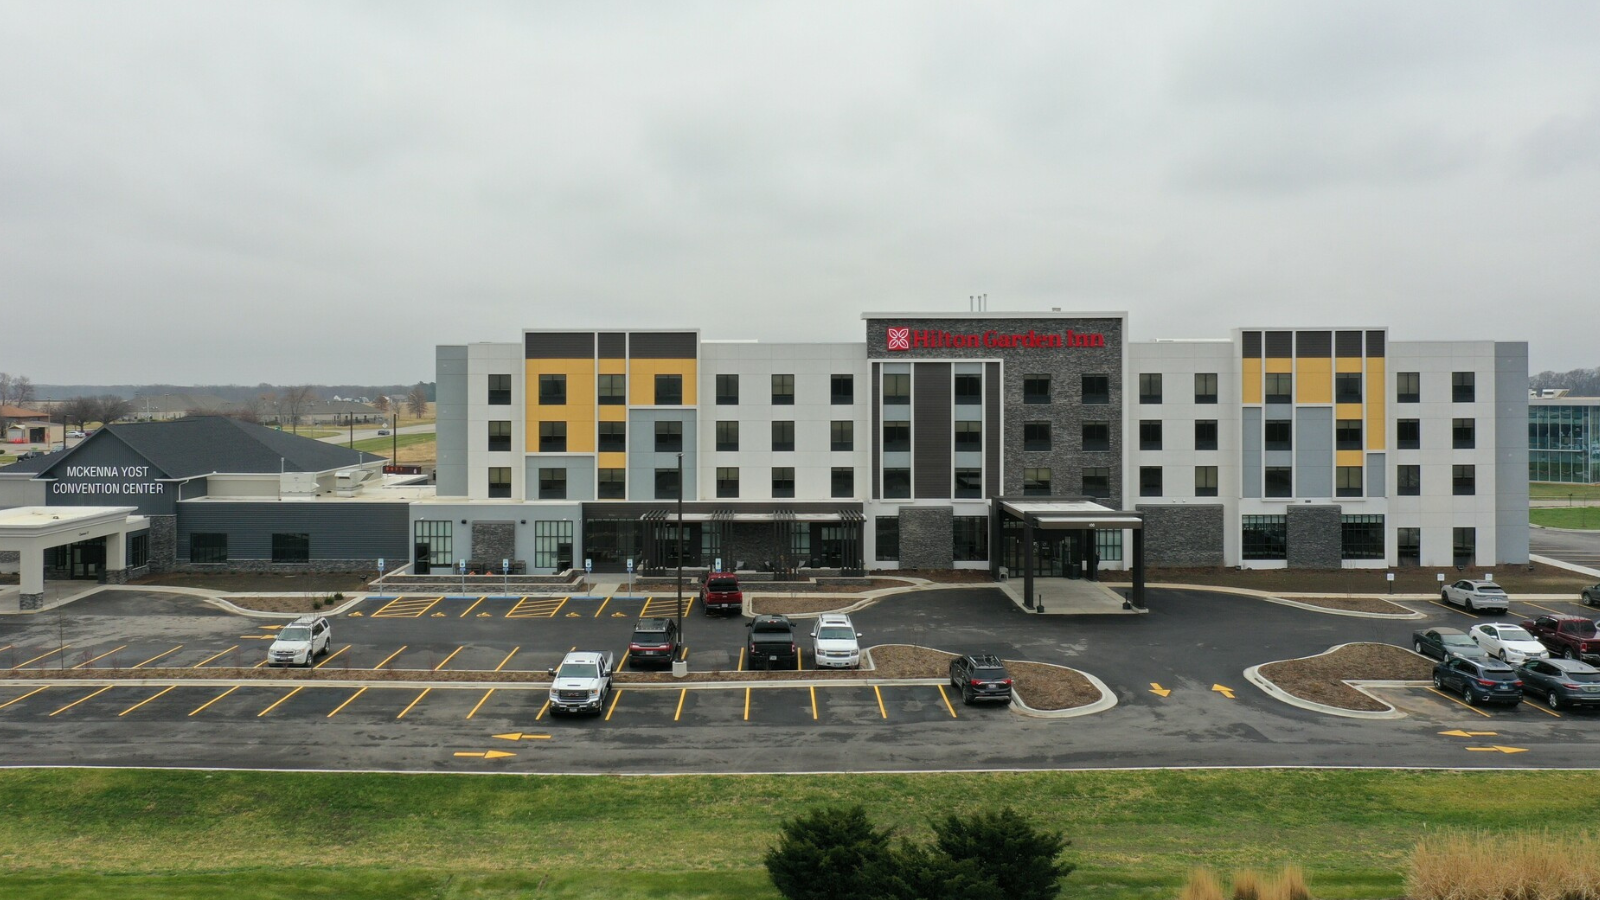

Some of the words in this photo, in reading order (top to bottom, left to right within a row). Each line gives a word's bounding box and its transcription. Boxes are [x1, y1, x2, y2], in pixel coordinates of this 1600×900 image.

[913, 329, 979, 348] Hilton
[983, 329, 1061, 348] Garden
[1066, 329, 1105, 348] Inn
[66, 466, 118, 477] MCKENNA
[121, 466, 149, 477] YOST
[53, 483, 119, 494] CONVENTION
[122, 483, 164, 494] CENTER
